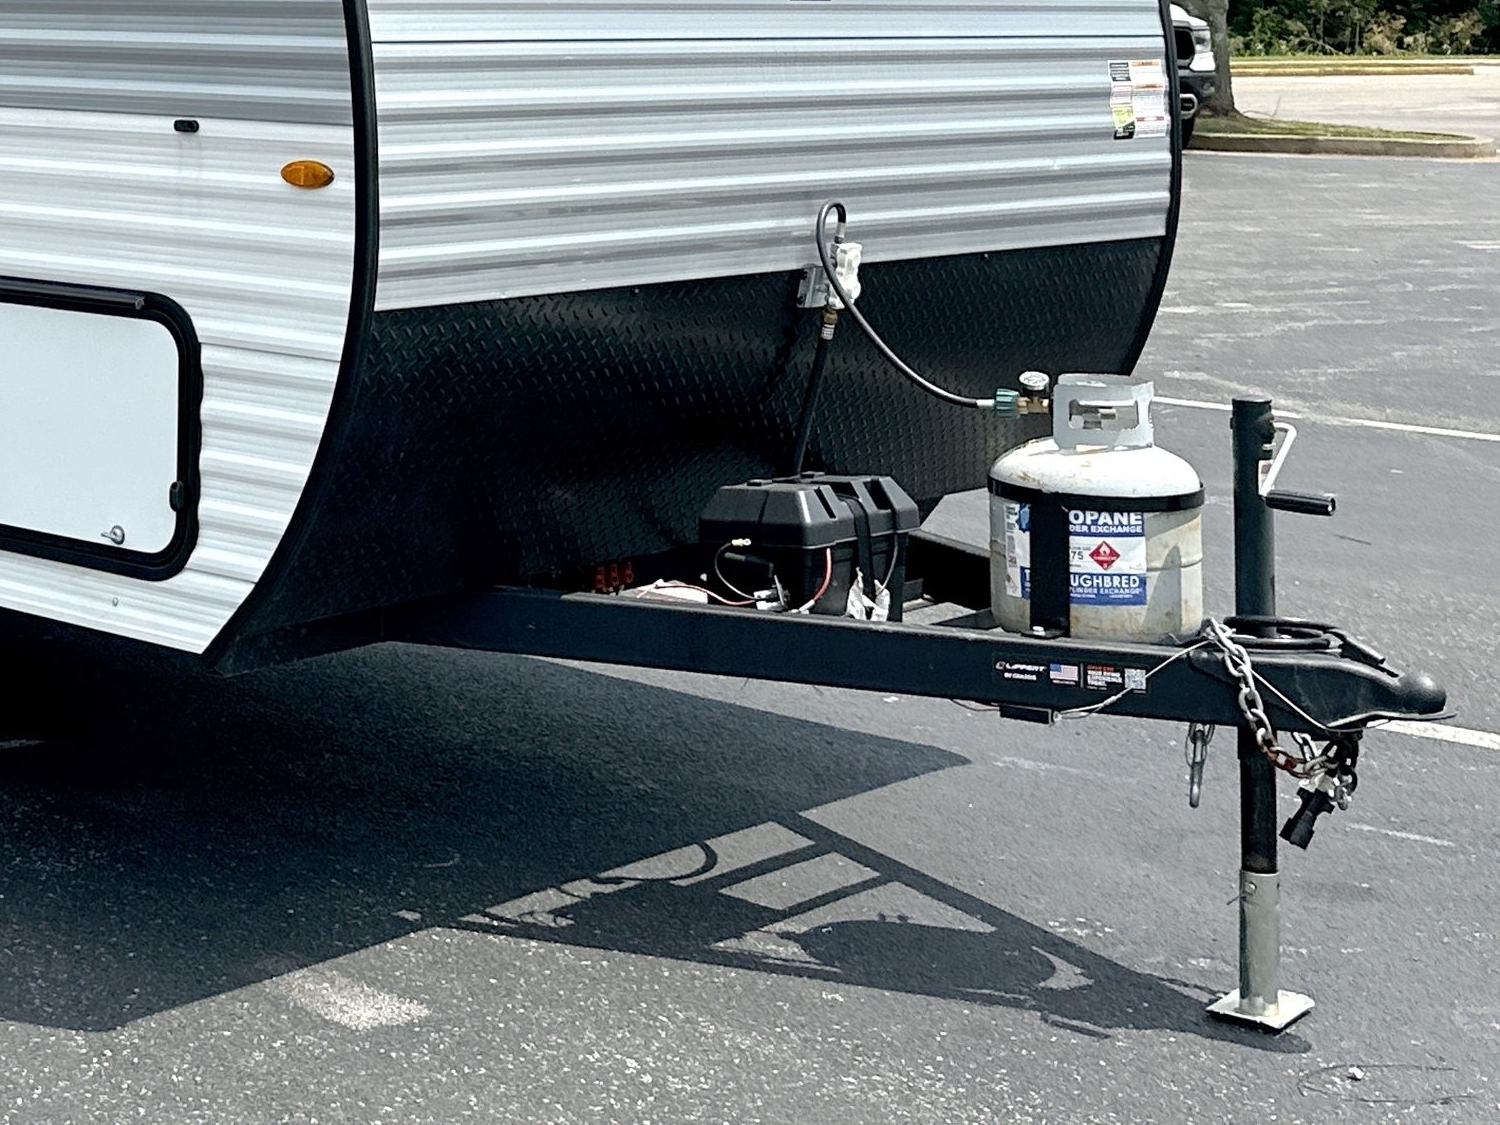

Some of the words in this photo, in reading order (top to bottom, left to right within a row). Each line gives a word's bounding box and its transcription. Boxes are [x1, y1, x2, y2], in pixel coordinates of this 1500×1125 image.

[1068, 510, 1143, 525] OPANE
[1091, 525, 1143, 533] EXCHANGE
[1070, 550, 1084, 561] 75
[1070, 574, 1140, 588] UGHBRED
